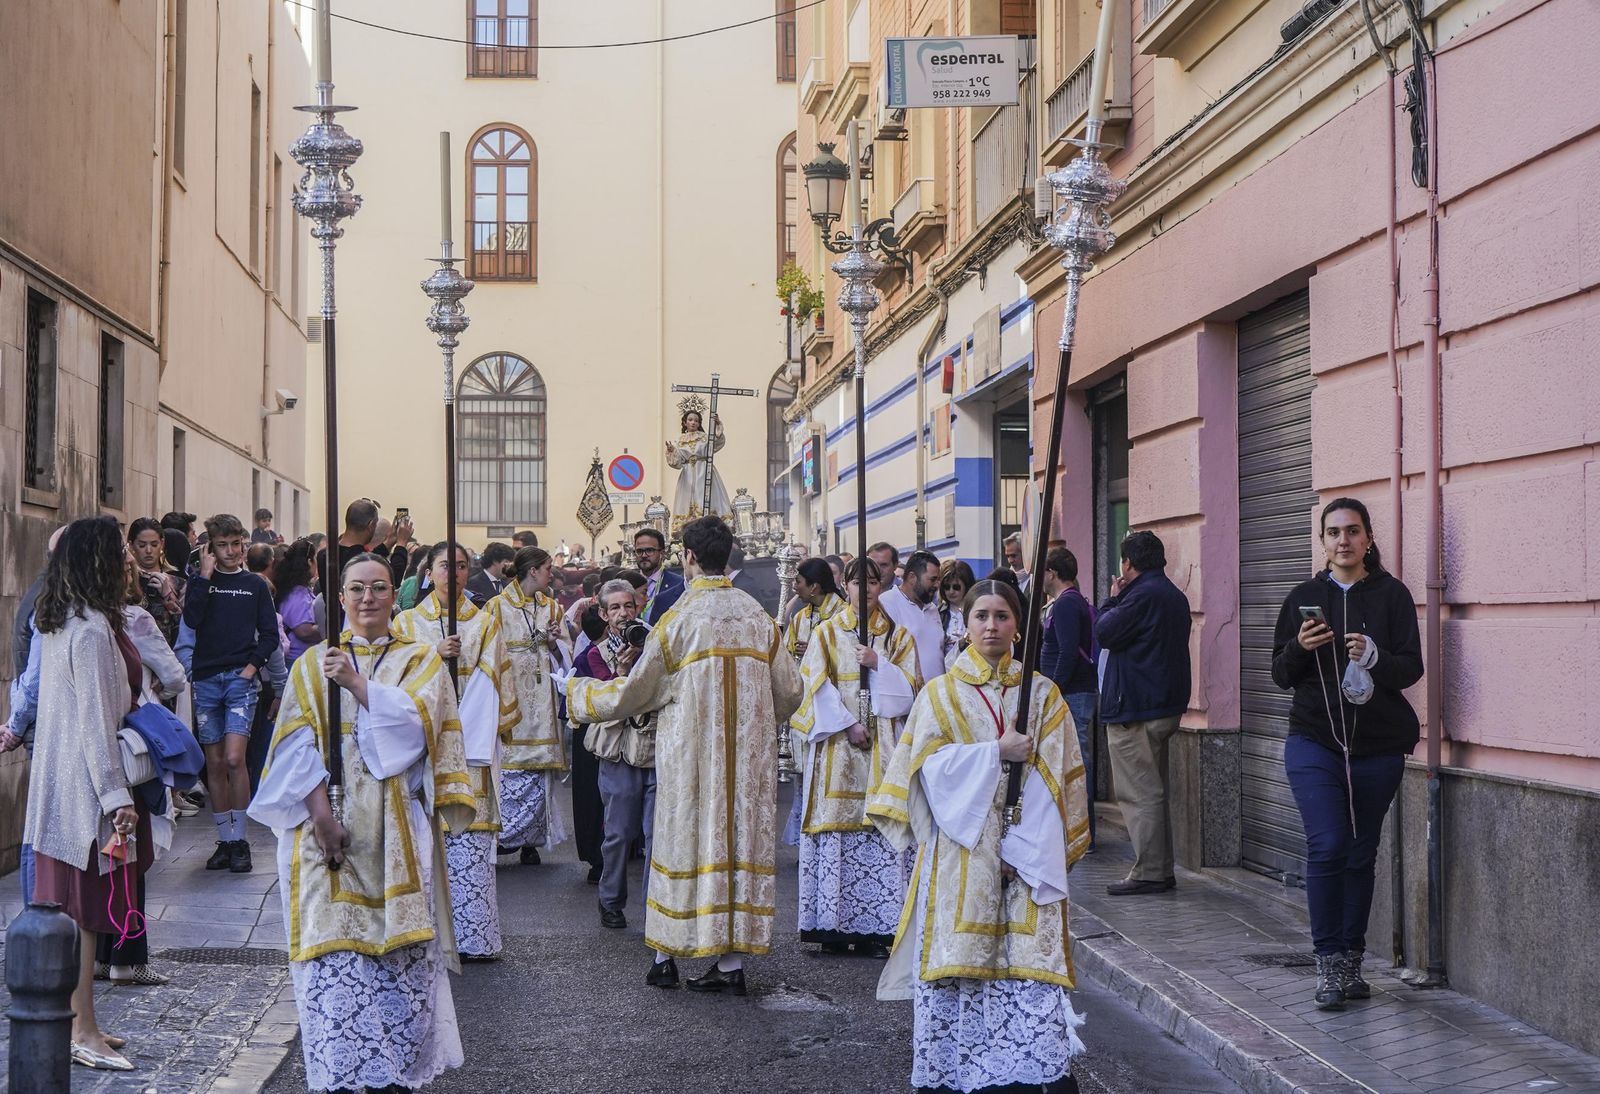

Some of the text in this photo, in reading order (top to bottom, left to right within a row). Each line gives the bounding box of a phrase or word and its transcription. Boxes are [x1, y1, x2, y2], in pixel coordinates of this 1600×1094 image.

[893, 45, 901, 72] DENTAL
[932, 66, 953, 74] Salud
[933, 89, 991, 99] 958 222 949
[208, 586, 253, 597] Champion
